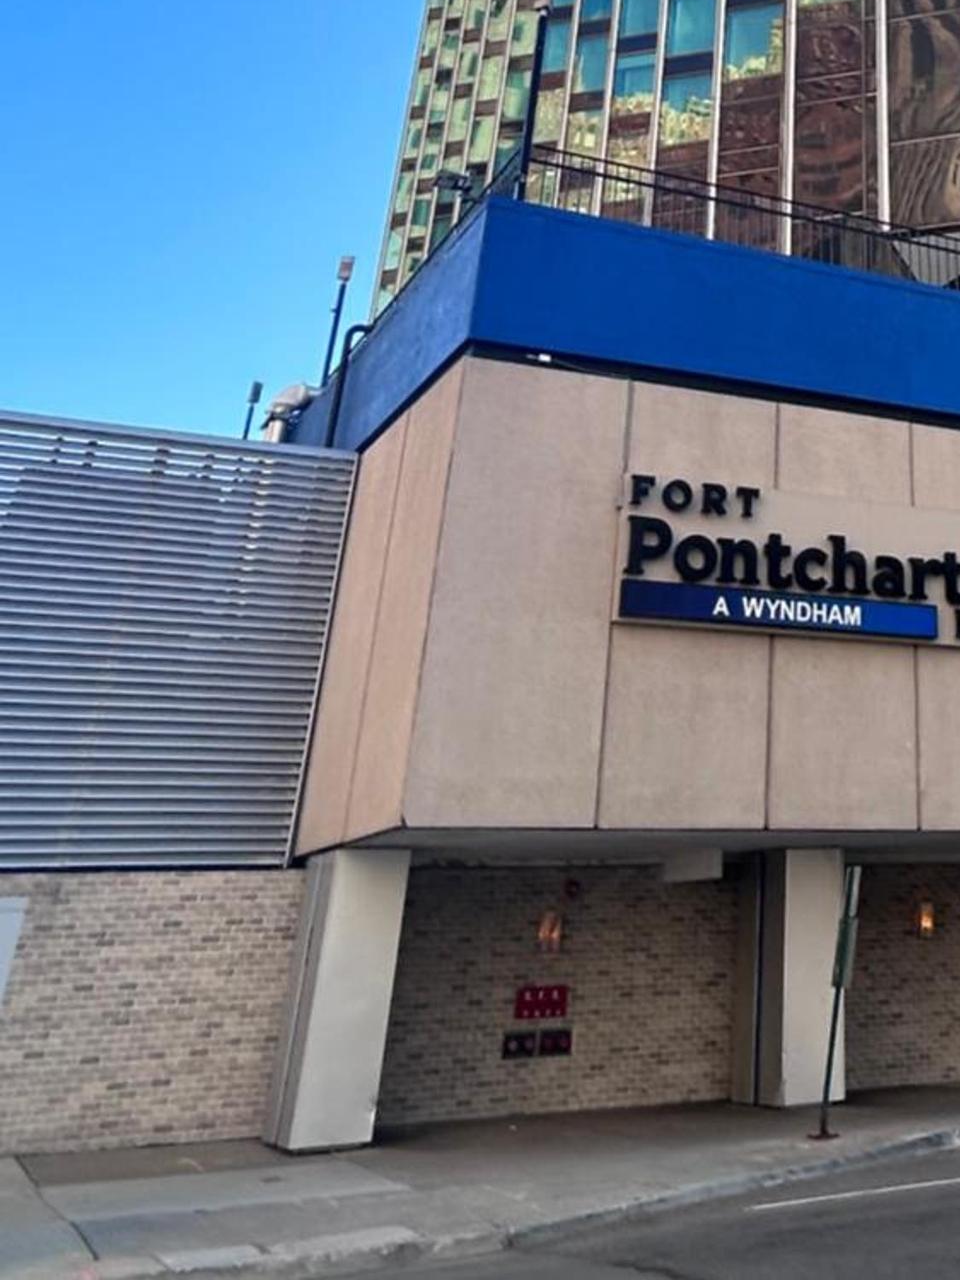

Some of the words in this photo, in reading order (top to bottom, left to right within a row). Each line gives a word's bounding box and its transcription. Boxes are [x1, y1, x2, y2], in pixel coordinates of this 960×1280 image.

[630, 474, 760, 517] FORT
[712, 596, 730, 617] A
[742, 597, 862, 627] WYNDHAM
